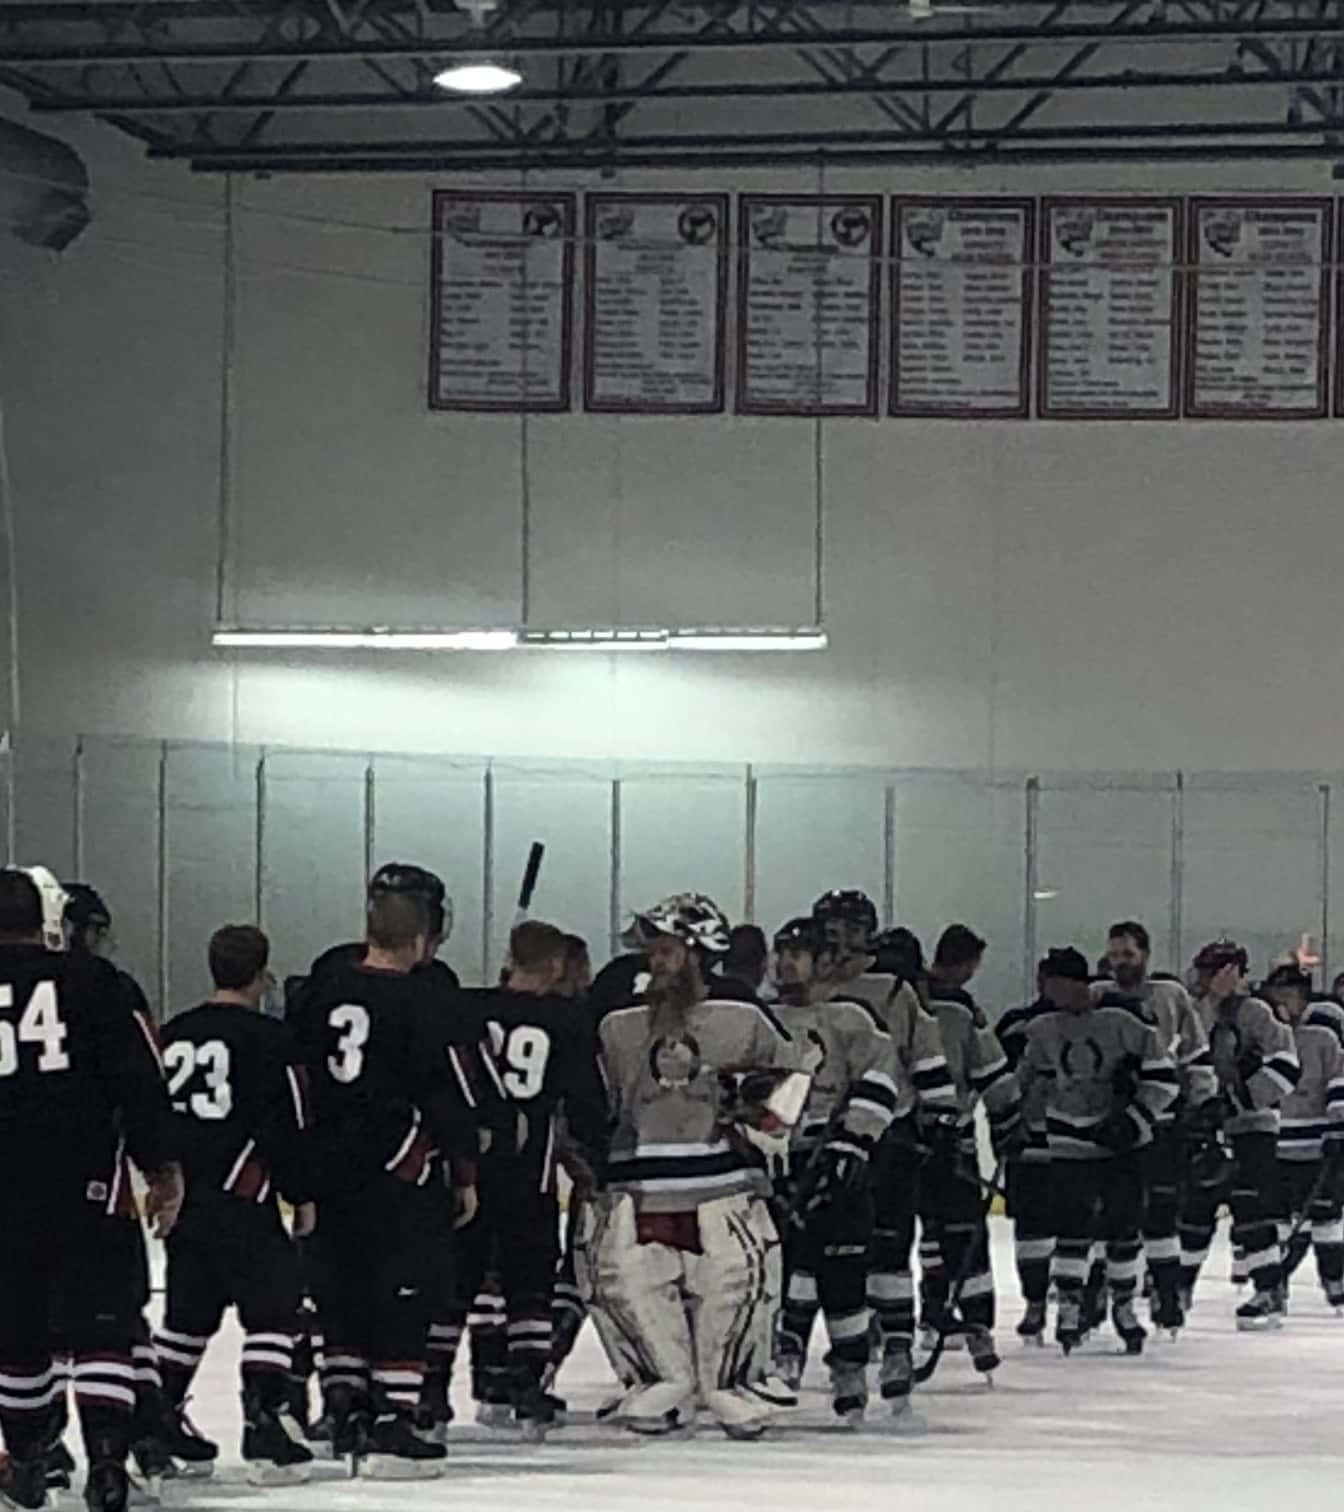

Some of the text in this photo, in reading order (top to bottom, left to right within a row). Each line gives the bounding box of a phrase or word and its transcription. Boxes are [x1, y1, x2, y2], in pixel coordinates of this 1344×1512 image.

[162, 1039, 232, 1119] 23
[327, 1004, 371, 1083] 3
[487, 1020, 550, 1099] 9
